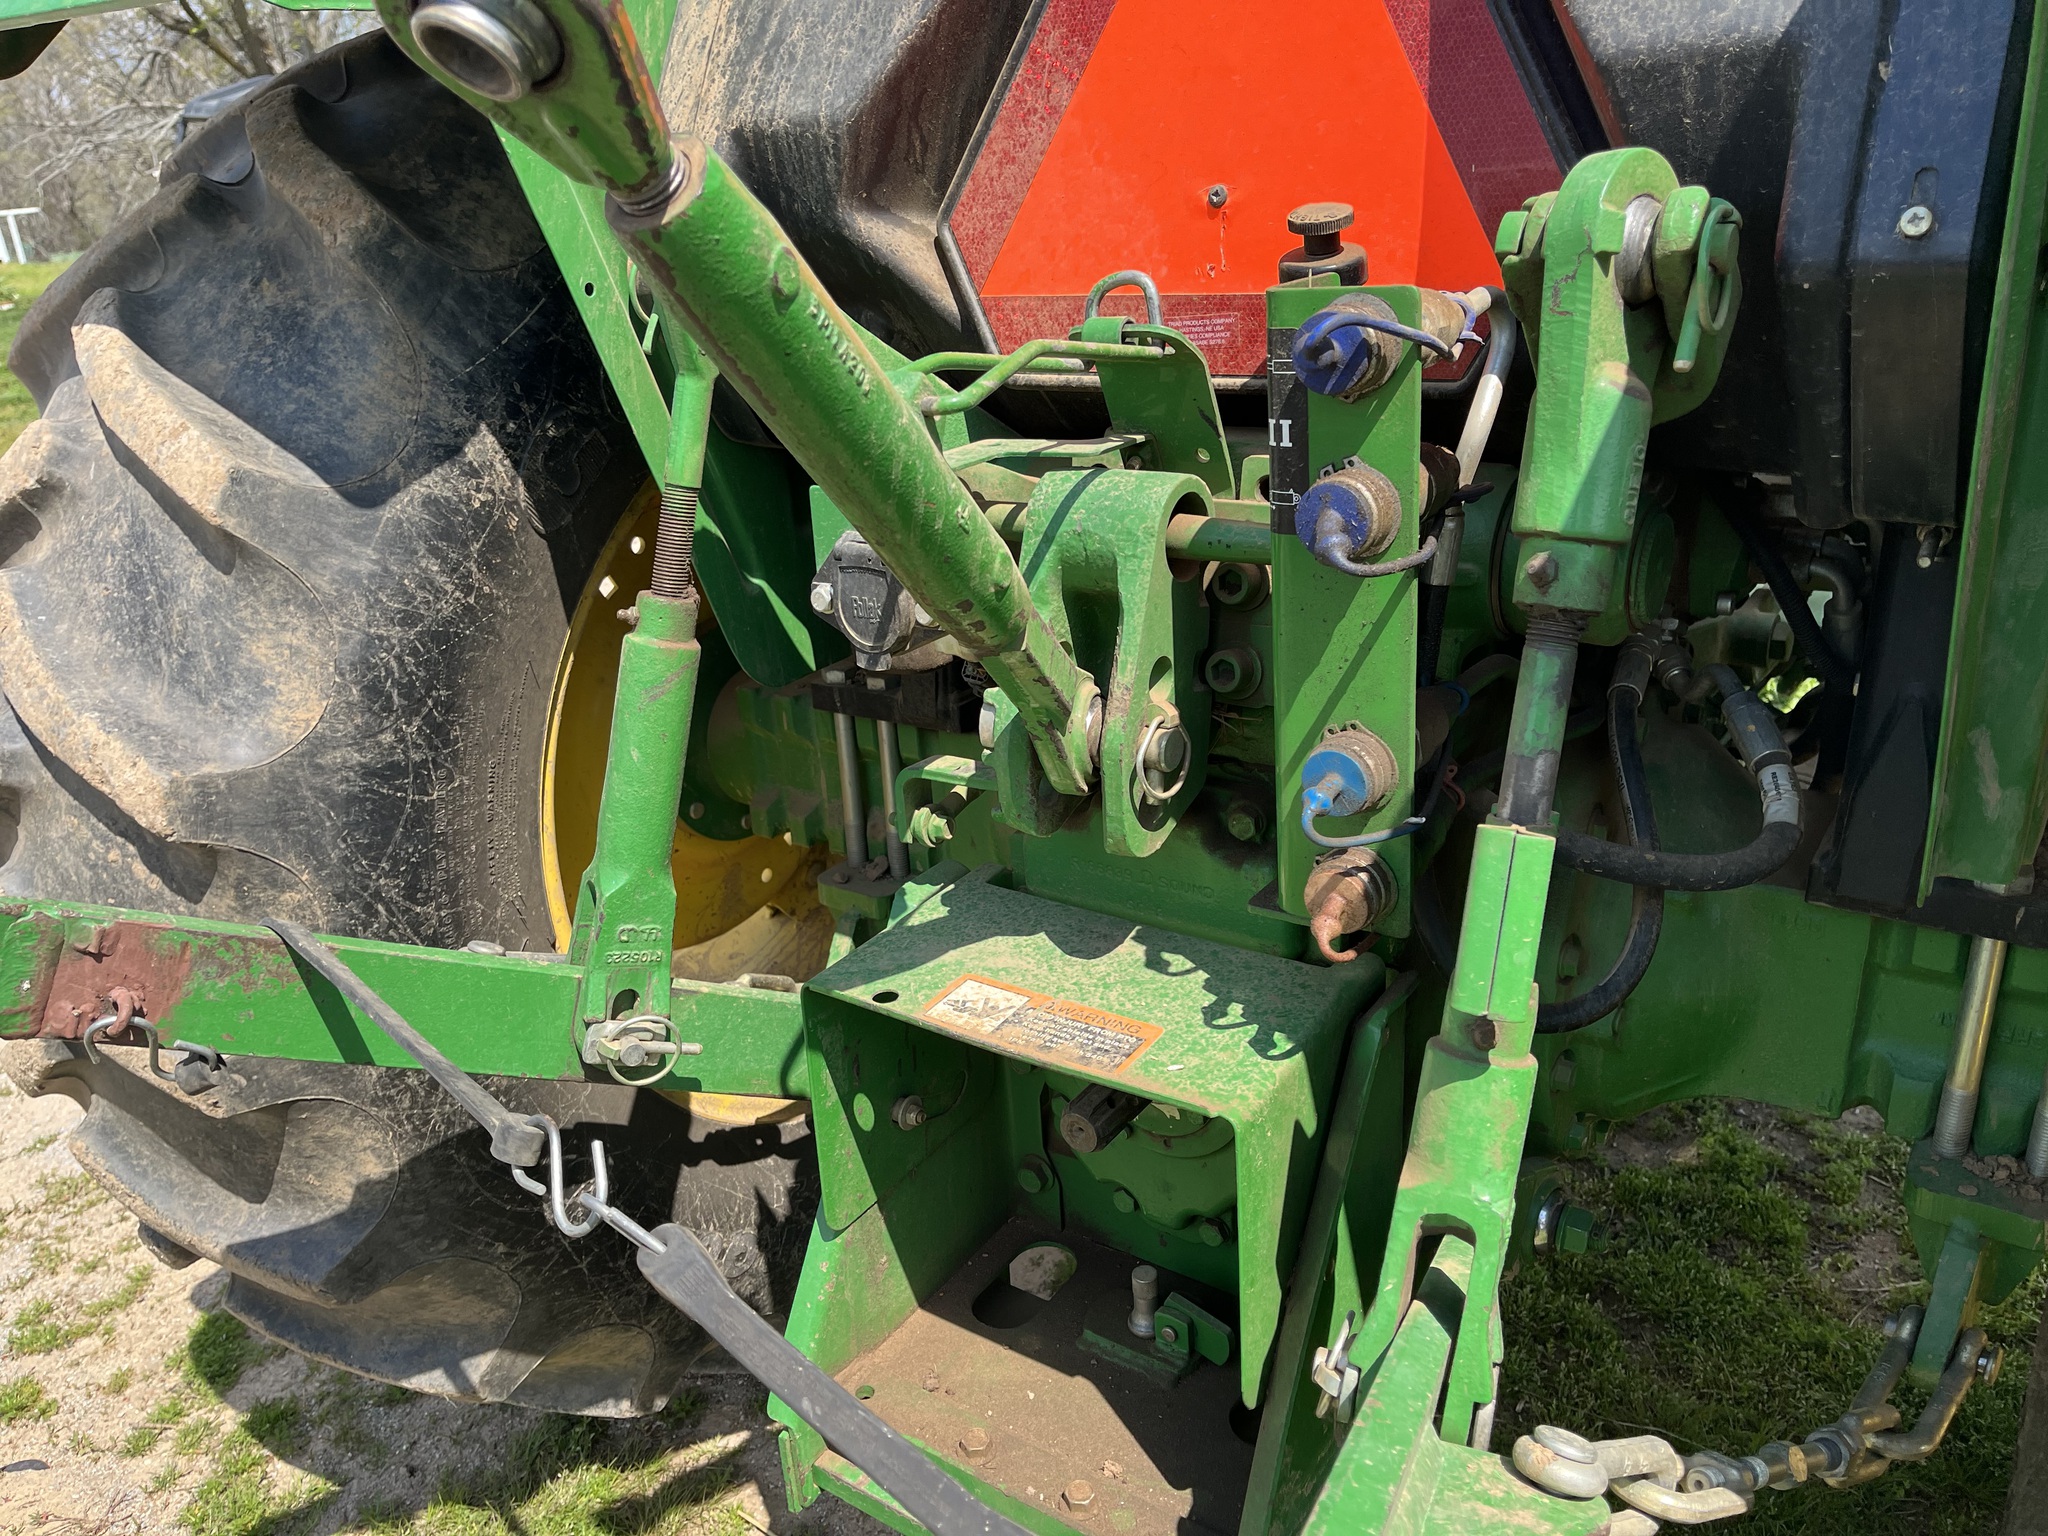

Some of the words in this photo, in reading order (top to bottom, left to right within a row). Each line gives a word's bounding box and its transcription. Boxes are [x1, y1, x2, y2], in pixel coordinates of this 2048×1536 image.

[851, 595, 882, 620] Pollak
[434, 767, 448, 834] RATING
[485, 760, 497, 823] WARNING
[486, 837, 497, 886] SAFETY
[1055, 1015, 1088, 1030] INJURY
[1088, 1026, 1116, 1038] FROM
[1116, 1031, 1137, 1043] PTO
[1058, 1006, 1142, 1034] WARNING
